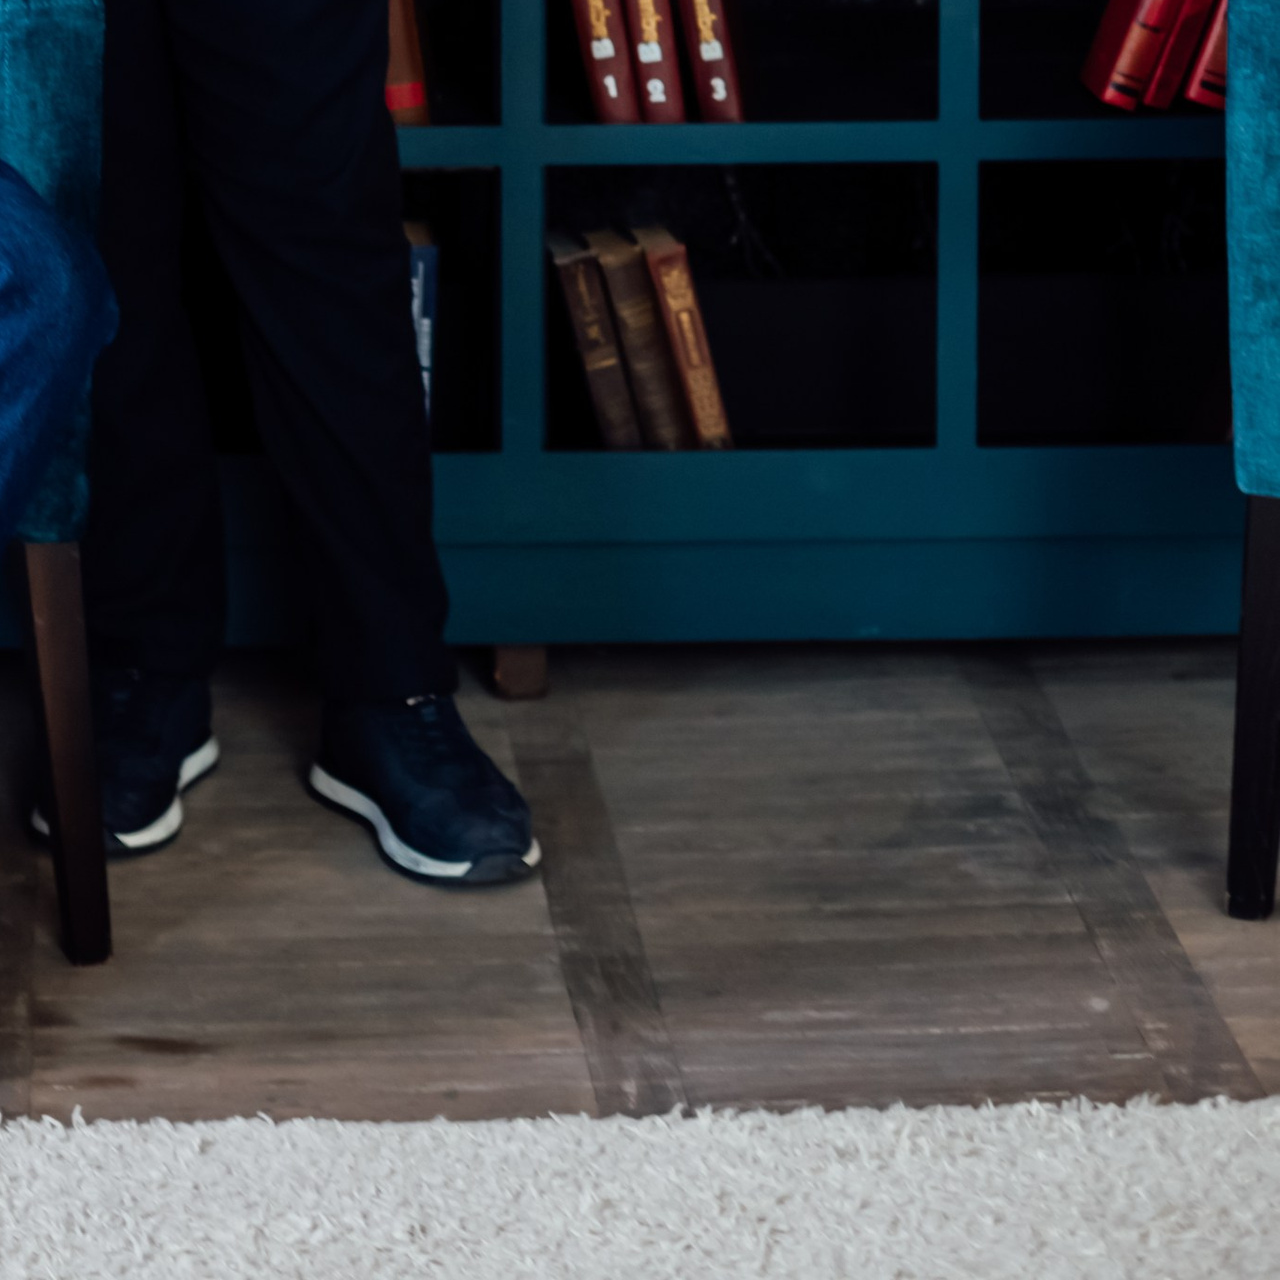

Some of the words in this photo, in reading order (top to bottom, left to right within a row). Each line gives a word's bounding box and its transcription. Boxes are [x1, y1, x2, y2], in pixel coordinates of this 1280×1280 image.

[602, 75, 619, 99] 1
[646, 79, 667, 103] 2
[711, 77, 728, 101] 3
